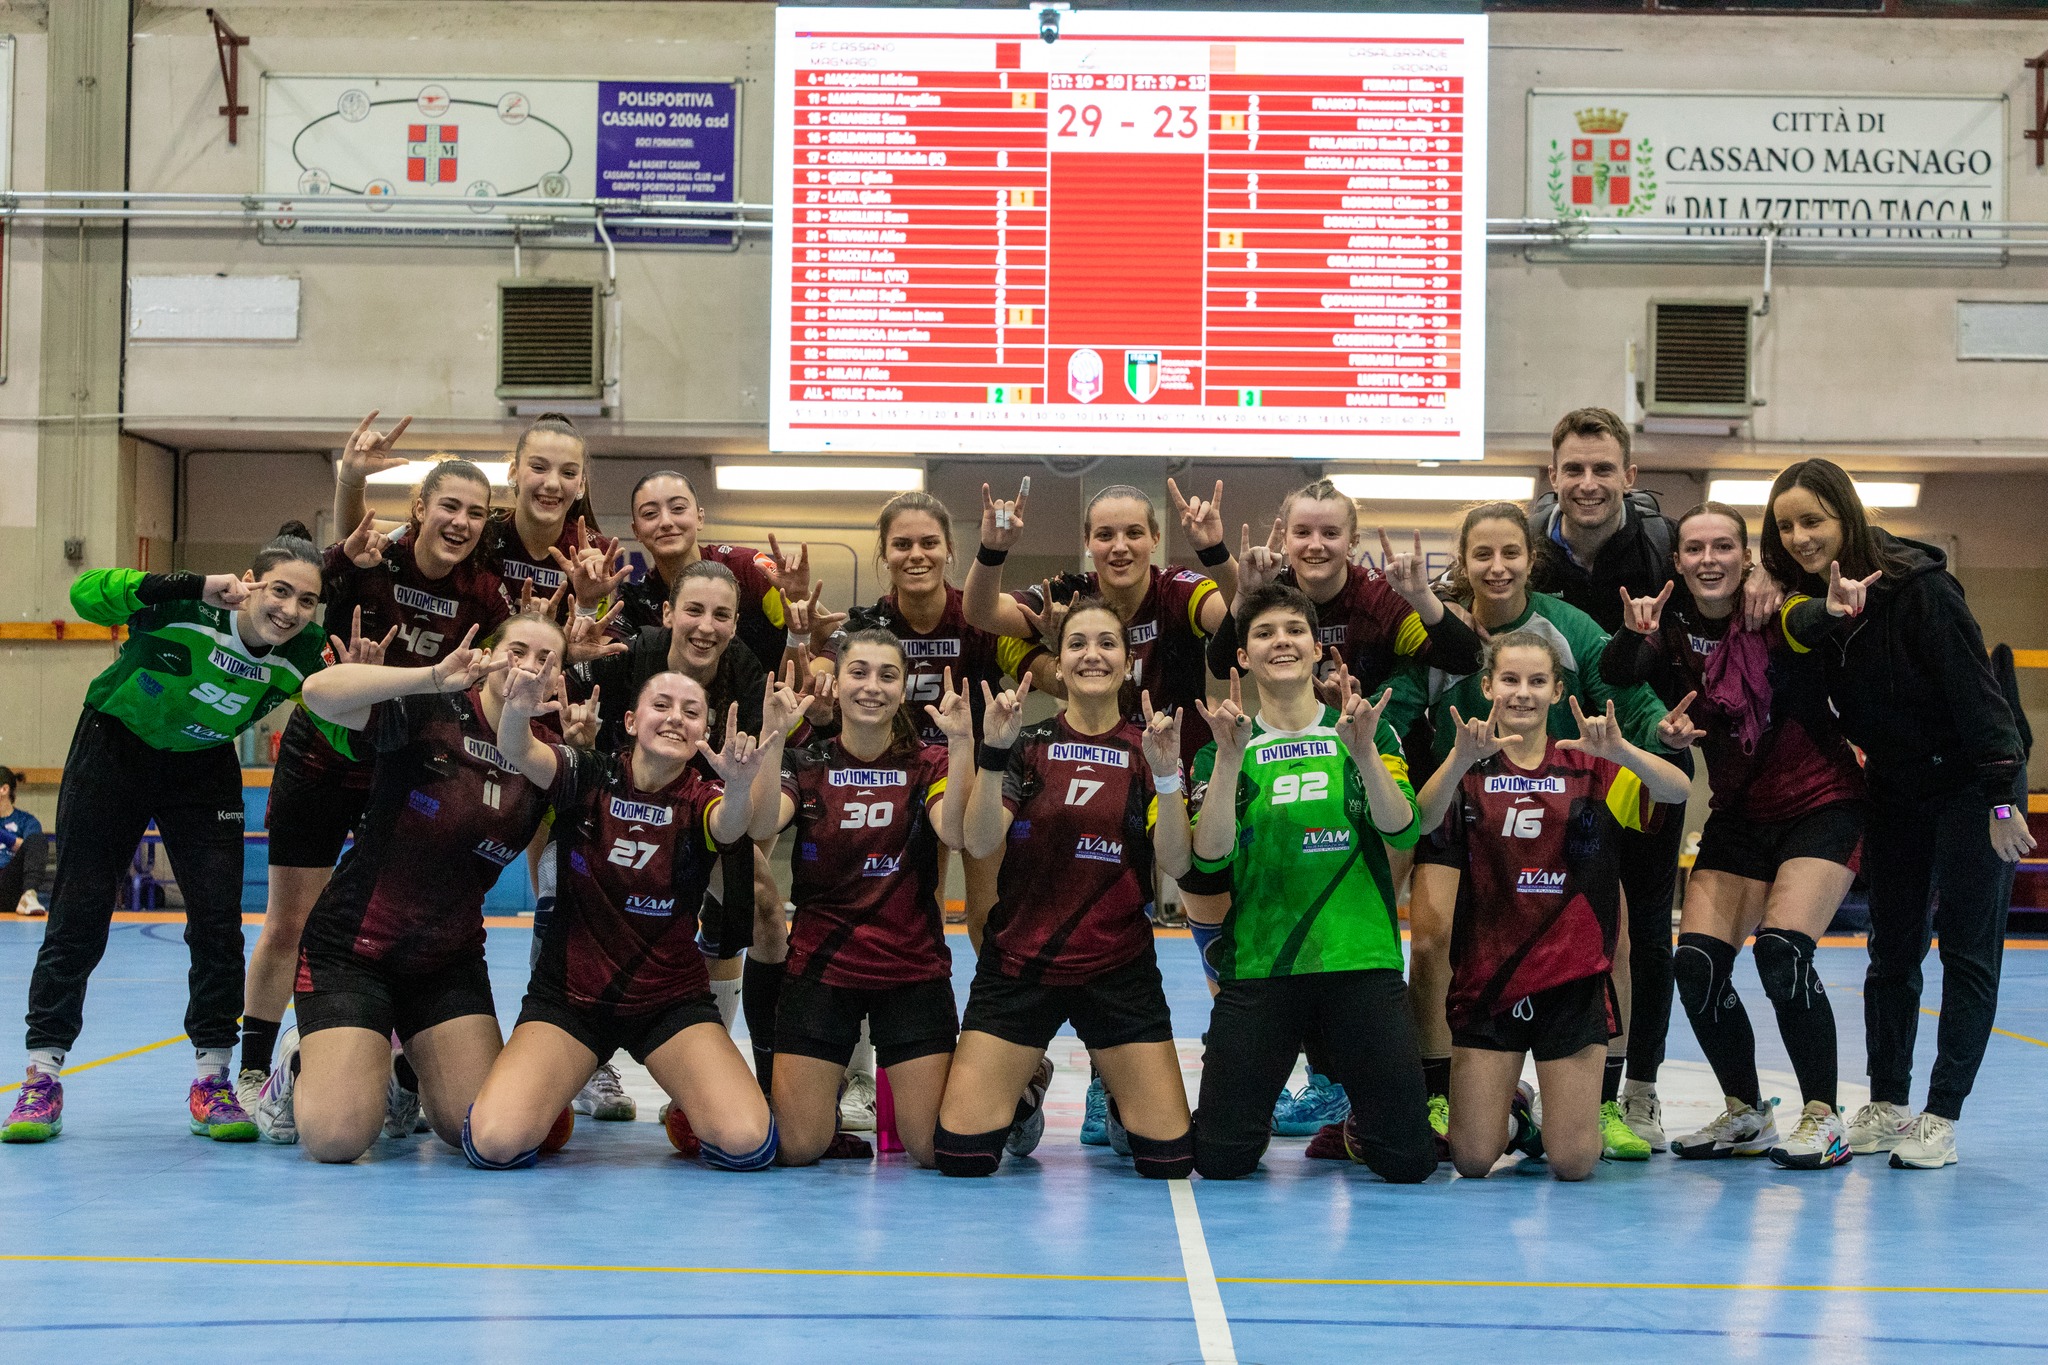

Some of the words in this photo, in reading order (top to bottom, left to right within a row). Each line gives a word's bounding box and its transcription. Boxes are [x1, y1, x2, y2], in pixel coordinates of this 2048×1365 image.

[618, 91, 714, 107] POLISPORTIVA
[602, 111, 666, 127] CASSANO
[669, 112, 702, 128] 2006
[705, 113, 729, 128] asd
[1057, 104, 1103, 138] 29
[1153, 105, 1198, 139] 23
[1773, 106, 1852, 133] CITTÀ
[1858, 113, 1885, 133] DI
[411, 145, 421, 157] C
[442, 145, 454, 157] M
[1666, 146, 1816, 174] CASSANO
[1824, 148, 1991, 176] MAGNAGO
[504, 562, 561, 586] AVIOMETAL
[397, 587, 453, 616] AVIOMETAL
[397, 622, 446, 658] 46
[189, 682, 250, 716] 95
[1052, 744, 1125, 766] AVIOMETAL
[1262, 742, 1332, 763] AVIOMETAL
[834, 769, 901, 786] AVIOMETAL
[1271, 771, 1329, 805] 92
[1491, 777, 1560, 792] AVIOMETAL
[482, 780, 501, 811] 11
[1064, 778, 1105, 806] 17
[840, 801, 894, 829] 30
[1501, 807, 1545, 839] 16
[607, 838, 660, 870] 27
